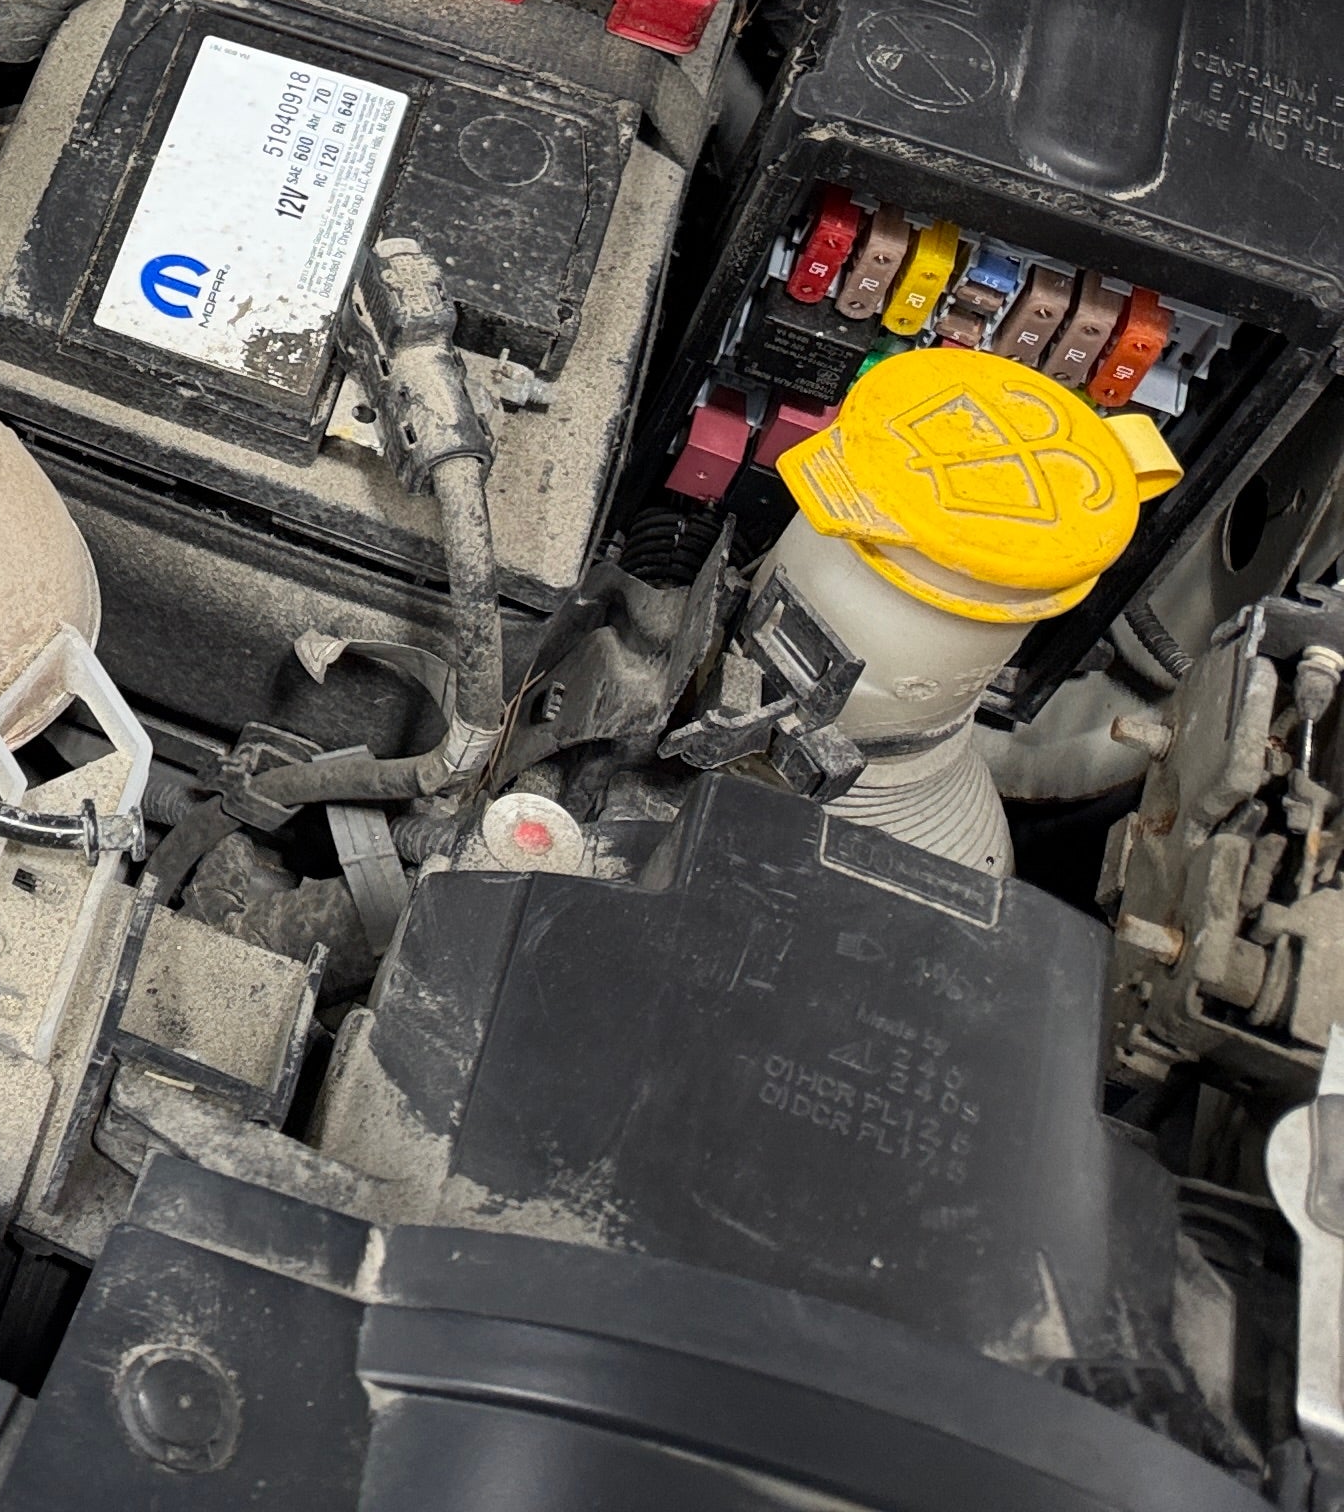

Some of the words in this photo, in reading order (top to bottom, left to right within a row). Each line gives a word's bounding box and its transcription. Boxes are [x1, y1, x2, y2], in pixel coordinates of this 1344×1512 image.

[313, 88, 332, 105] 70
[337, 92, 358, 117] 640
[262, 71, 311, 158] 51940918
[306, 113, 321, 131] Ahr
[331, 121, 347, 135] EN
[293, 136, 314, 162] 600
[318, 144, 340, 168] 120
[286, 165, 303, 185] SAE
[312, 173, 329, 188] RC
[275, 185, 309, 220] 12V
[808, 261, 829, 278] 50
[858, 277, 880, 292] 70
[198, 268, 228, 329] MOPAR
[1016, 330, 1040, 346] 70
[1064, 348, 1087, 363] 70
[1112, 365, 1135, 380] 40
